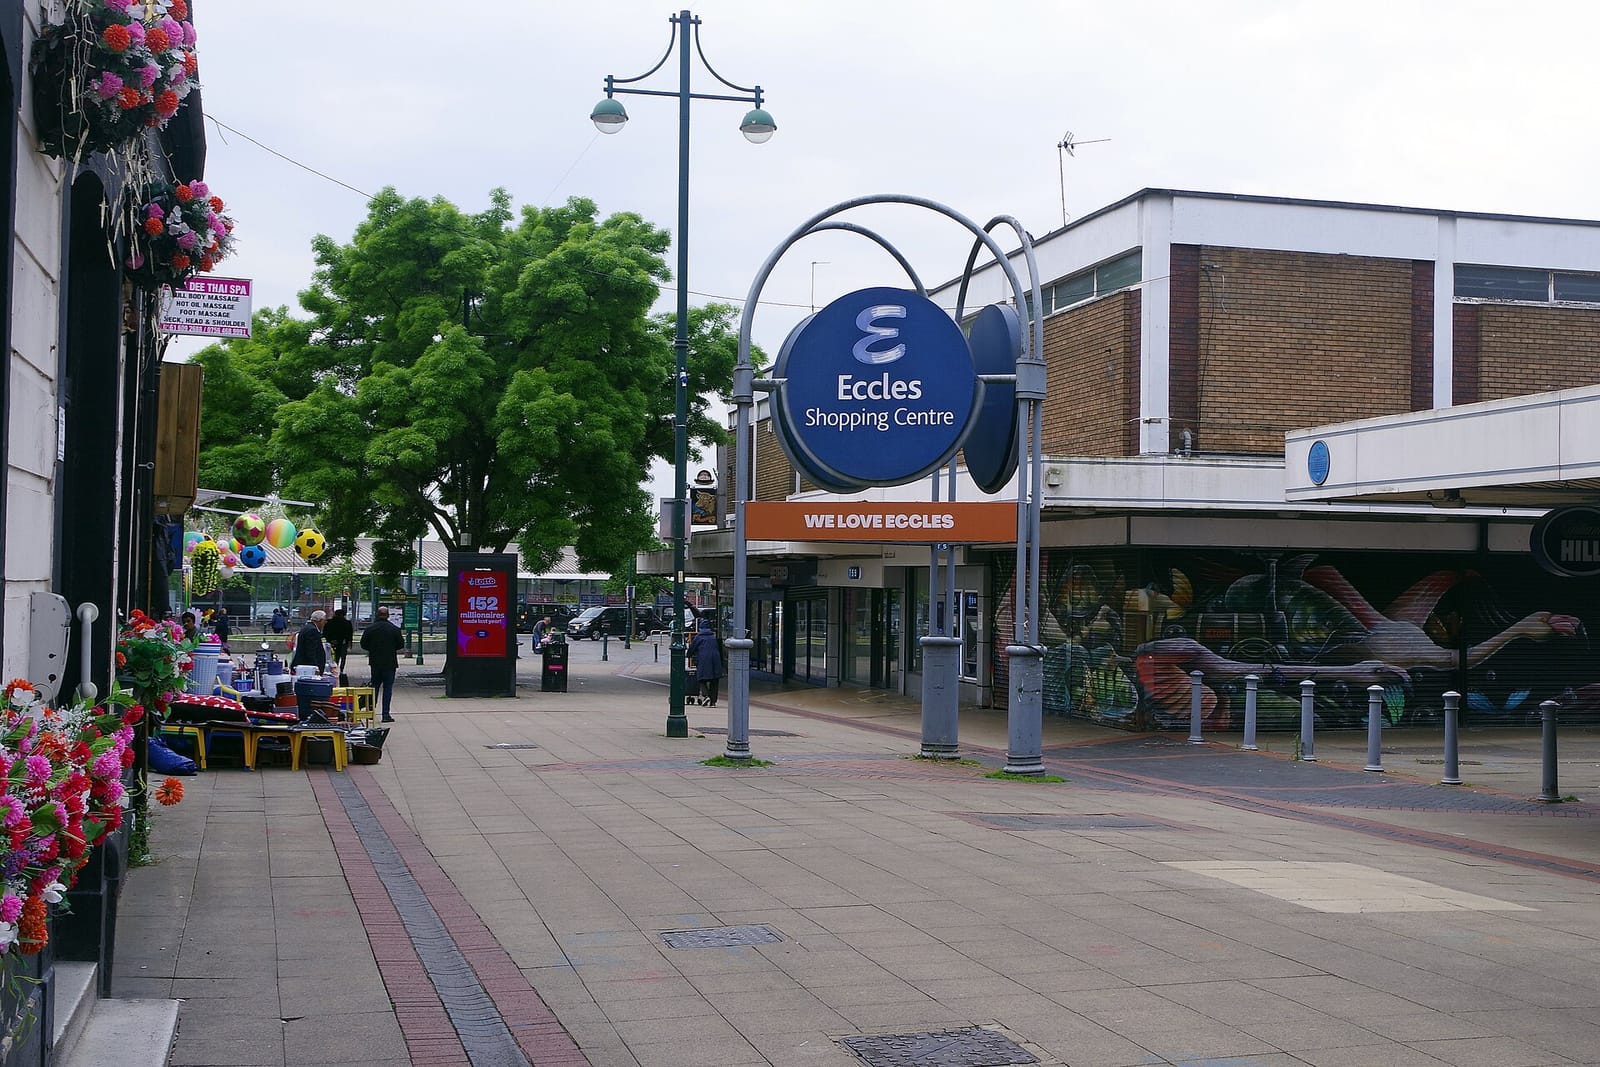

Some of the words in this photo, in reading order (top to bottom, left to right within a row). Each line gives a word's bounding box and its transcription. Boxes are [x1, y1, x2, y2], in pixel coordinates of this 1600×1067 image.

[189, 281, 205, 291] DEE
[207, 283, 228, 293] THAI
[229, 284, 247, 295] SPA
[207, 294, 240, 302] MASSAGE
[198, 310, 231, 318] MASSAGE
[212, 319, 246, 327] SHOULDER
[838, 372, 922, 401] Eccles
[805, 407, 889, 432] Shopping
[894, 407, 954, 425] Centre
[804, 514, 835, 529] WE
[837, 514, 883, 529] LOVE
[885, 514, 955, 529] ECCLES
[468, 597, 498, 610] 152
[460, 611, 505, 619] millionaires
